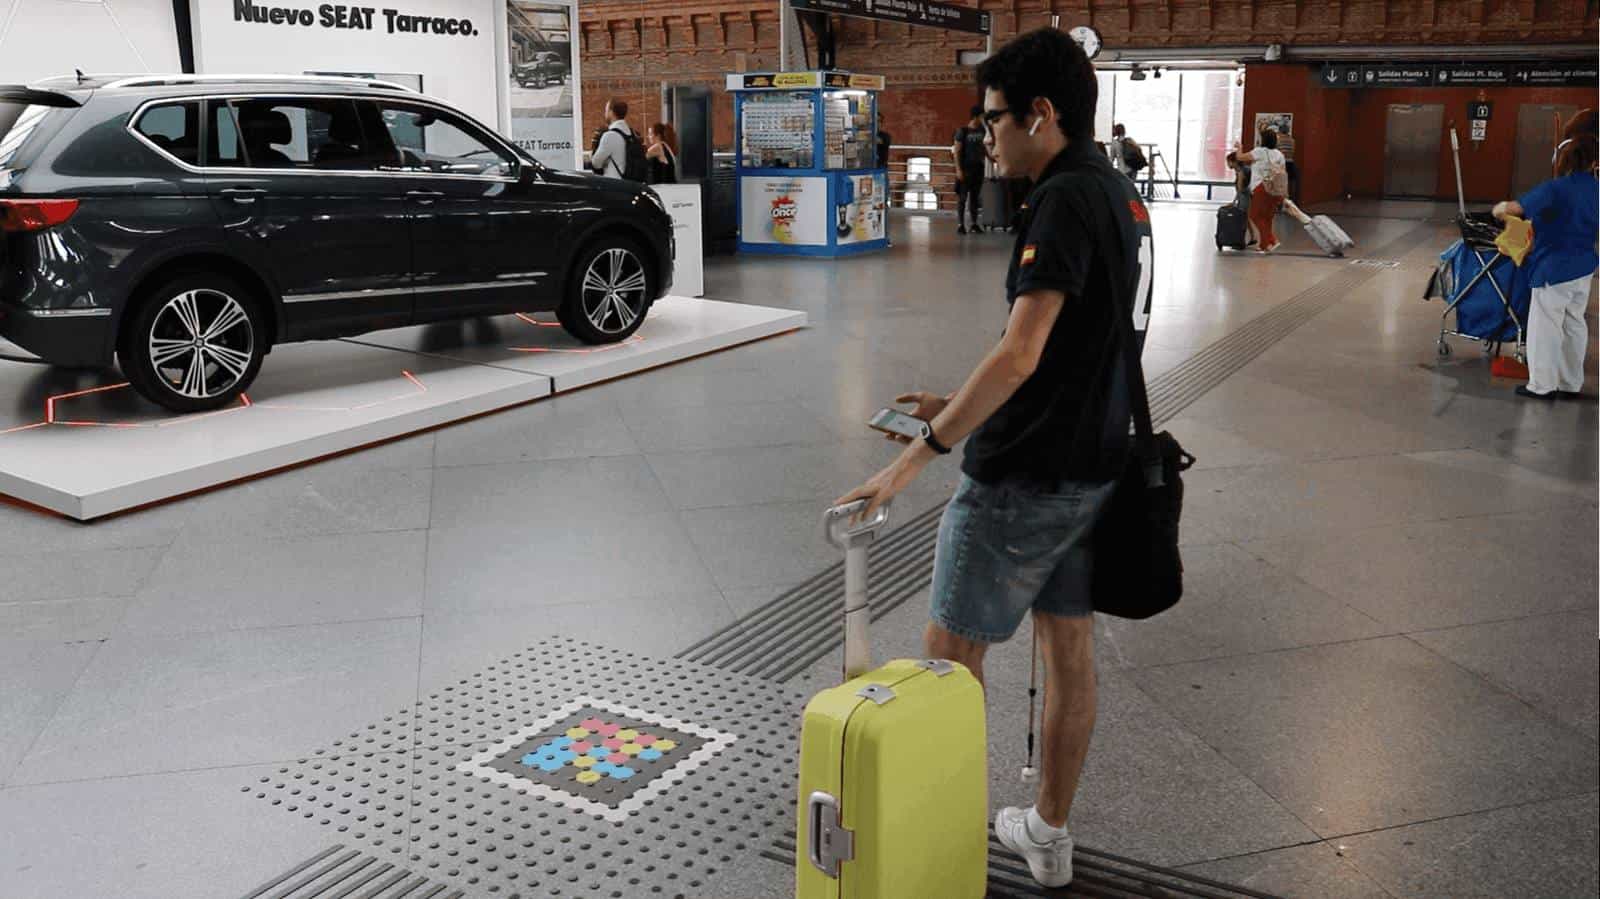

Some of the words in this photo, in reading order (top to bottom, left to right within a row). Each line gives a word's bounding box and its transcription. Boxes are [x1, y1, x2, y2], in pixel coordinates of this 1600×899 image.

[233, 0, 314, 26] Nuevo
[319, 4, 375, 30] SEAT
[383, 9, 479, 36] Tarraco.
